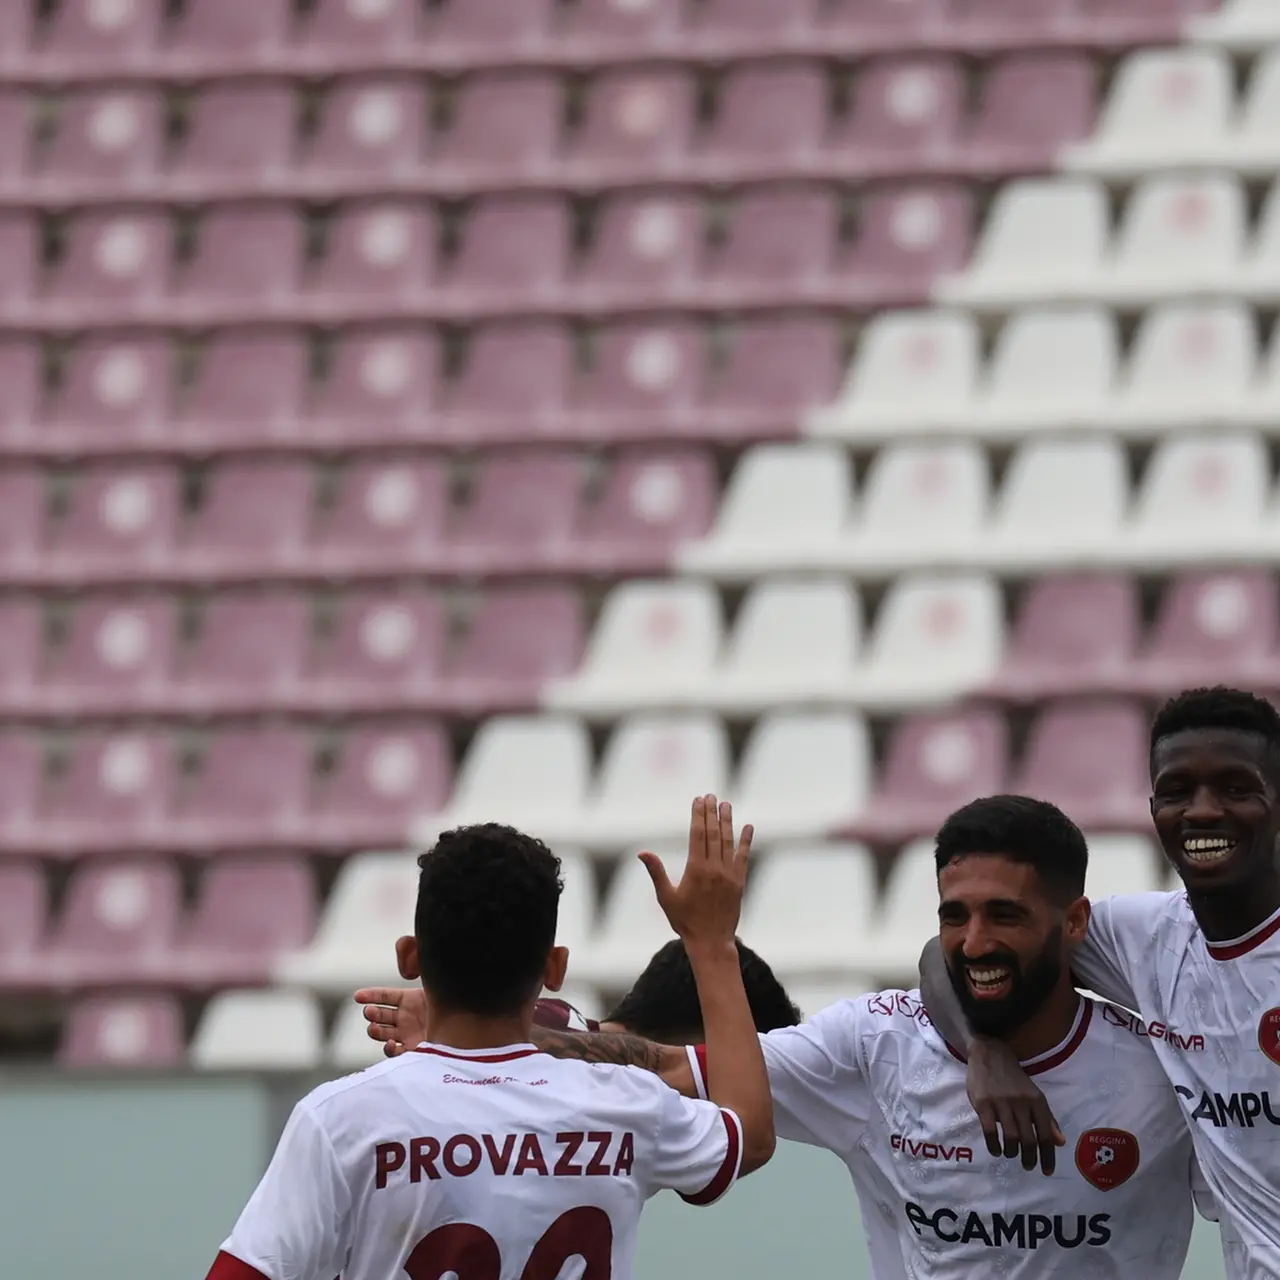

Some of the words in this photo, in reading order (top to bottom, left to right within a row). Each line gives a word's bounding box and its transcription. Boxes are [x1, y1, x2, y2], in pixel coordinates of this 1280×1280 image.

[890, 1133, 974, 1164] GIVOVA
[1088, 1135, 1127, 1146] REGGINA
[375, 1131, 635, 1190] PROVAZZA
